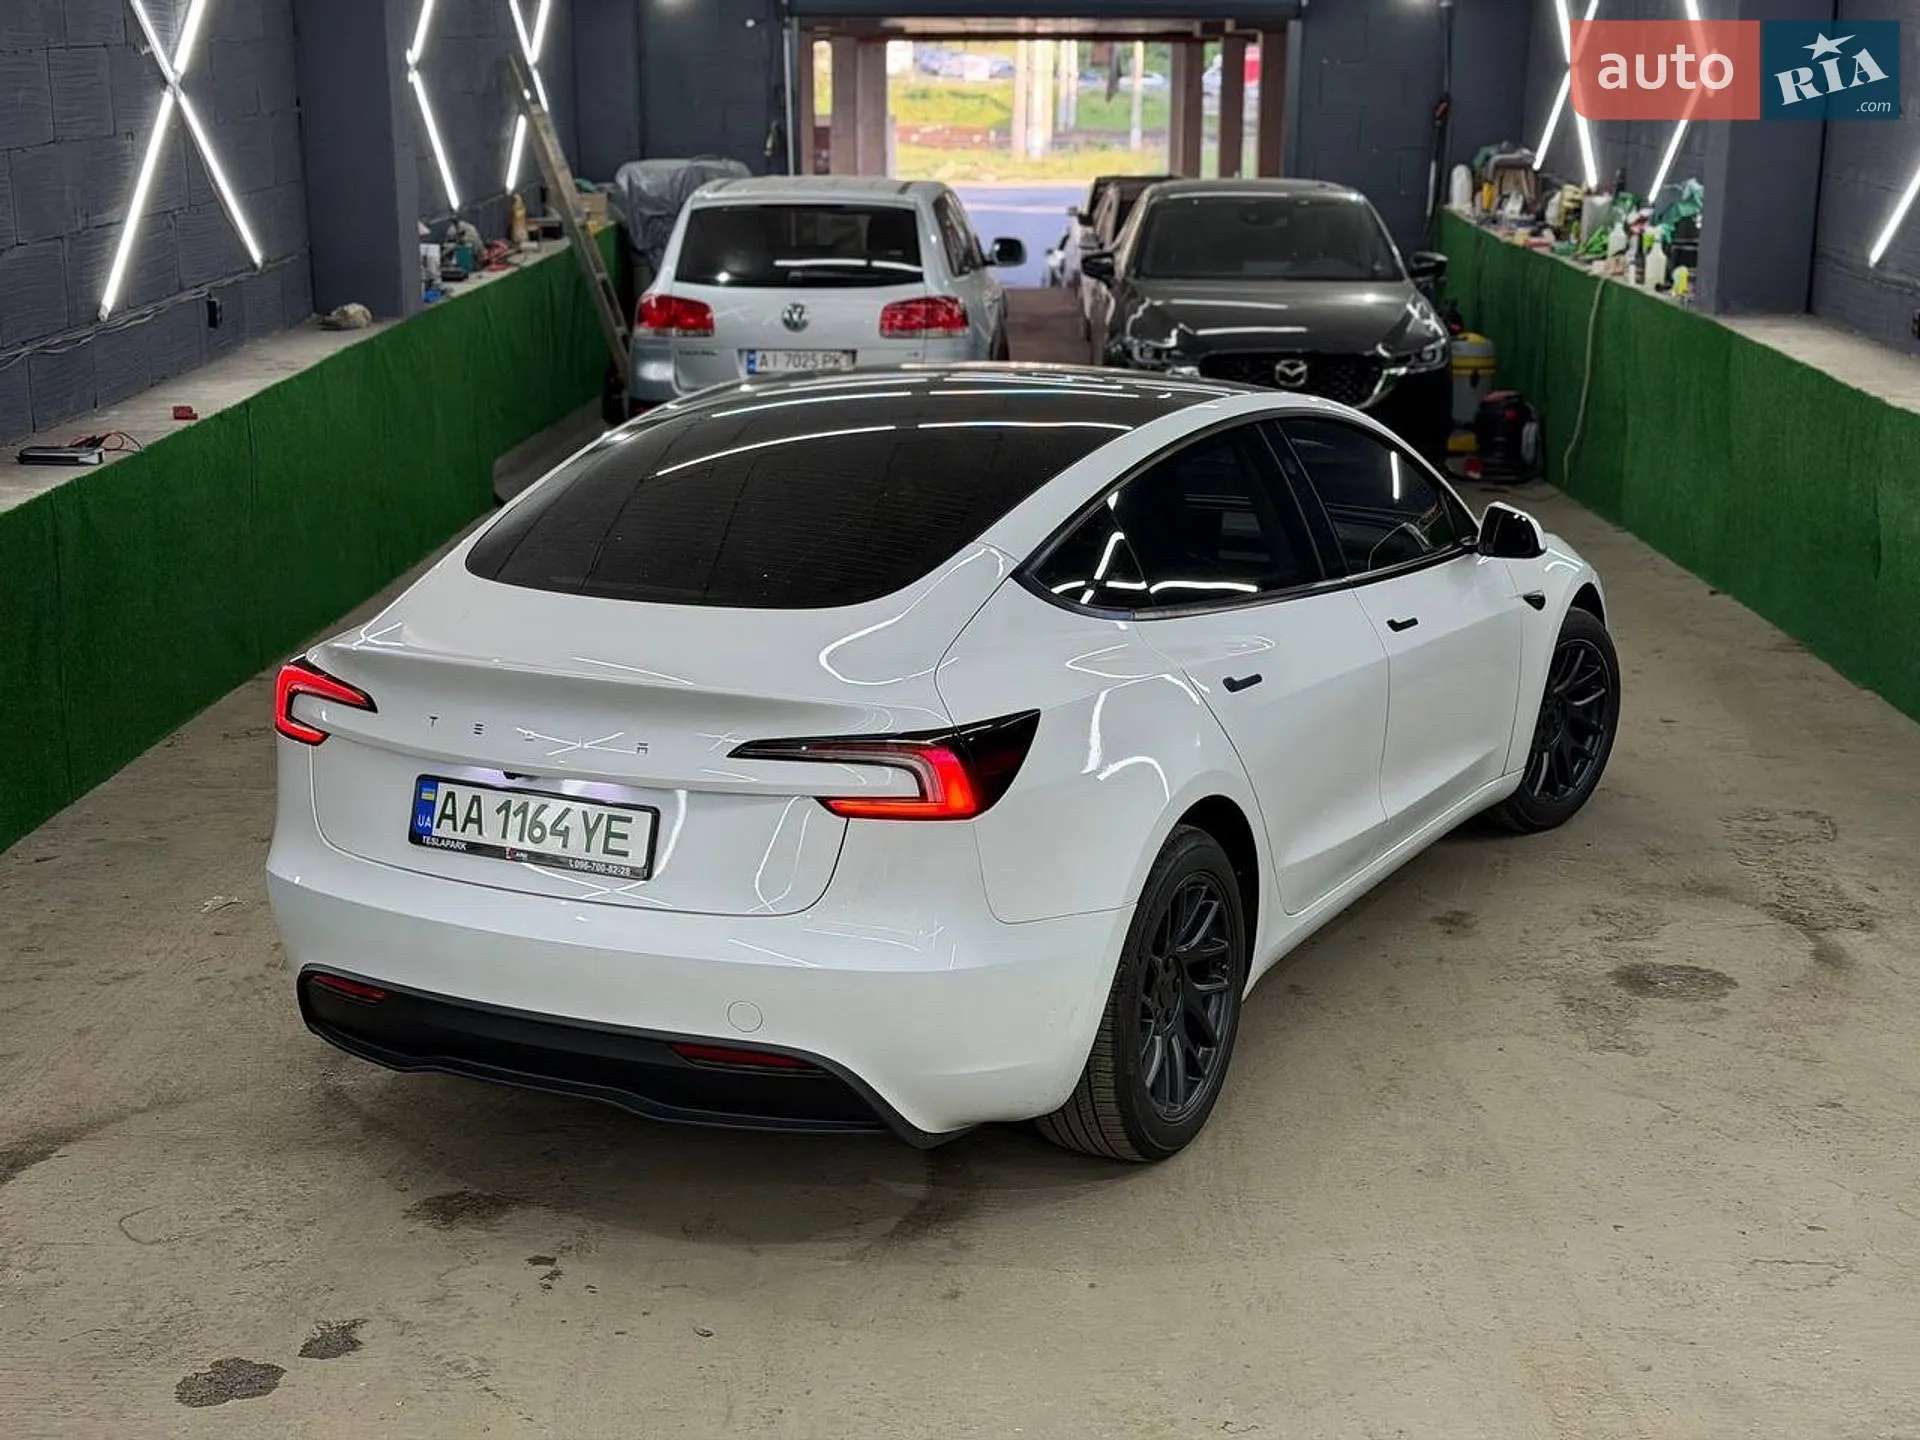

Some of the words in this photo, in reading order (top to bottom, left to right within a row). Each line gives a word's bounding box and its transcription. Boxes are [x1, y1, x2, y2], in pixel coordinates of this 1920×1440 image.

[784, 352, 818, 369] 7025
[417, 815, 432, 828] UA
[435, 791, 484, 836] AA
[495, 799, 570, 849] 1164
[582, 810, 633, 858] YE
[421, 835, 468, 851] TESLAPARK
